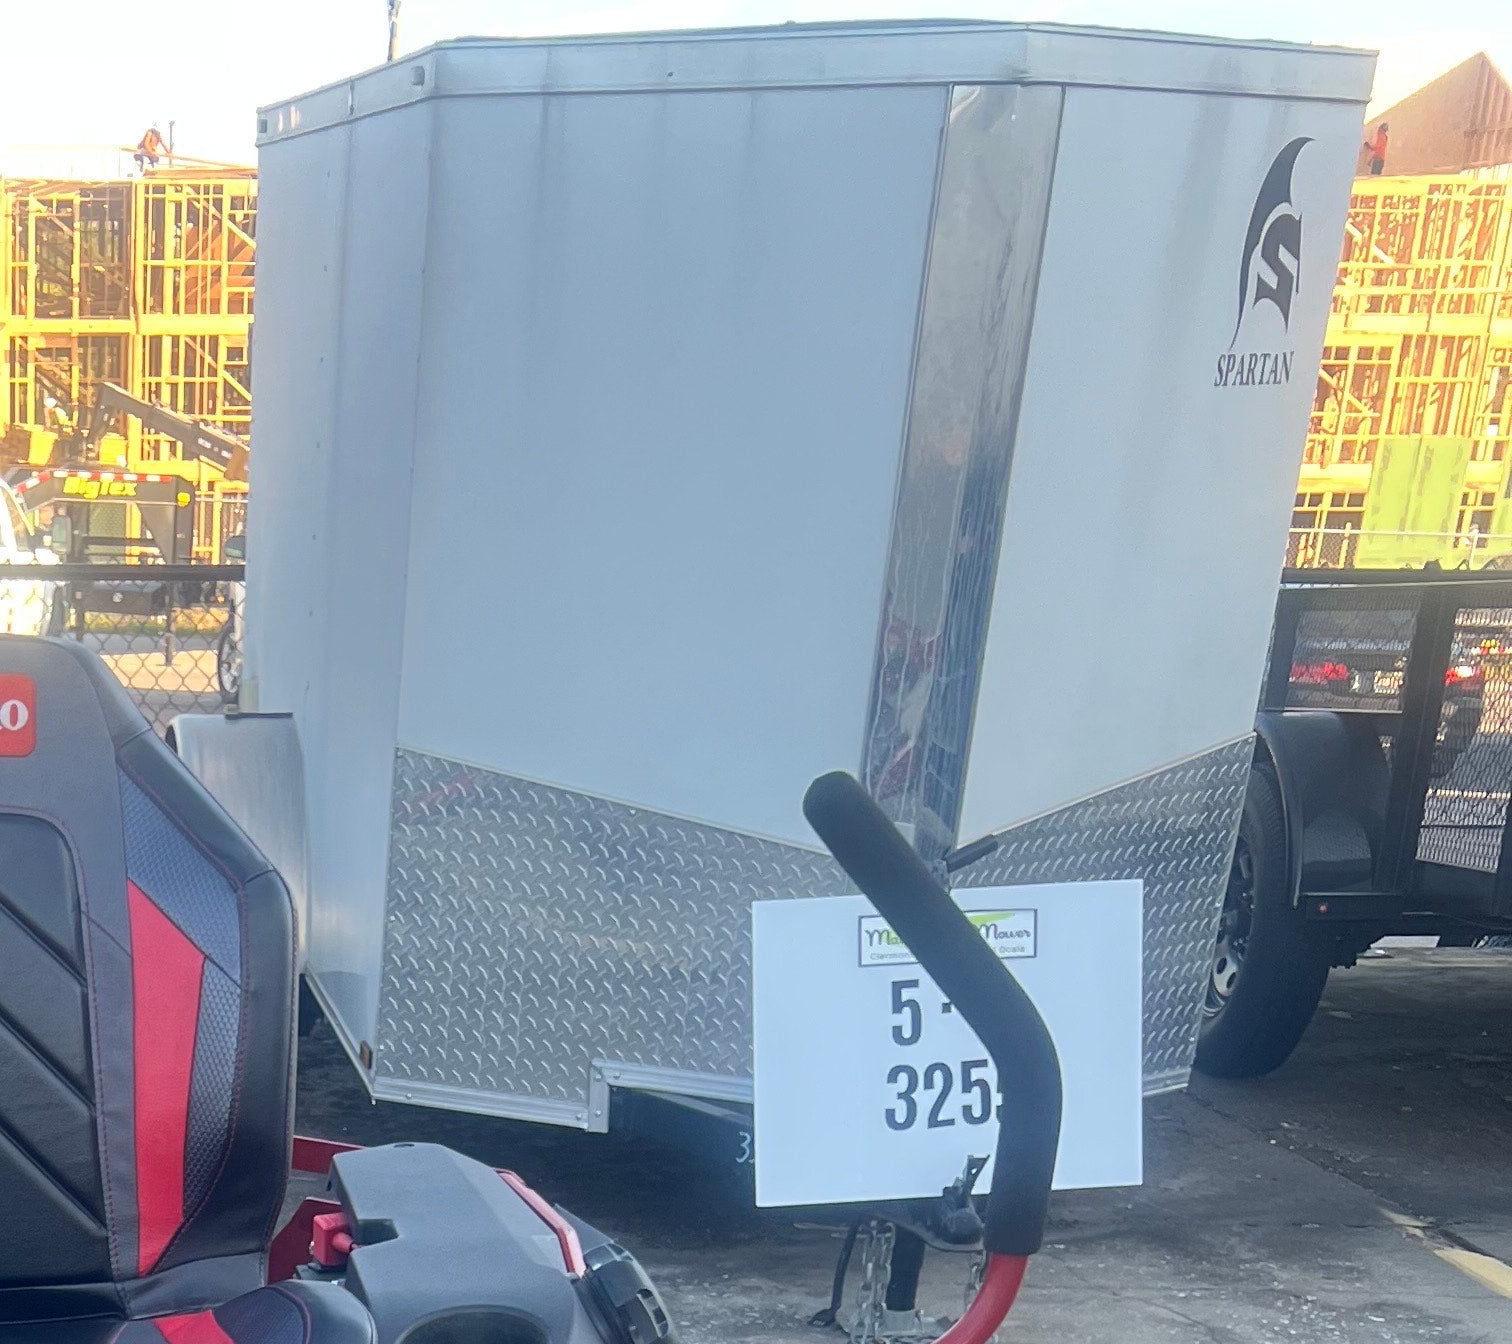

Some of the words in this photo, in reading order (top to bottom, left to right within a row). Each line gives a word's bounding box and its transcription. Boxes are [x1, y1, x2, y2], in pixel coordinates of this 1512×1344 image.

[1213, 350, 1295, 388] SPARTAN
[864, 928, 904, 948] Ma
[885, 1058, 1002, 1132] 325
